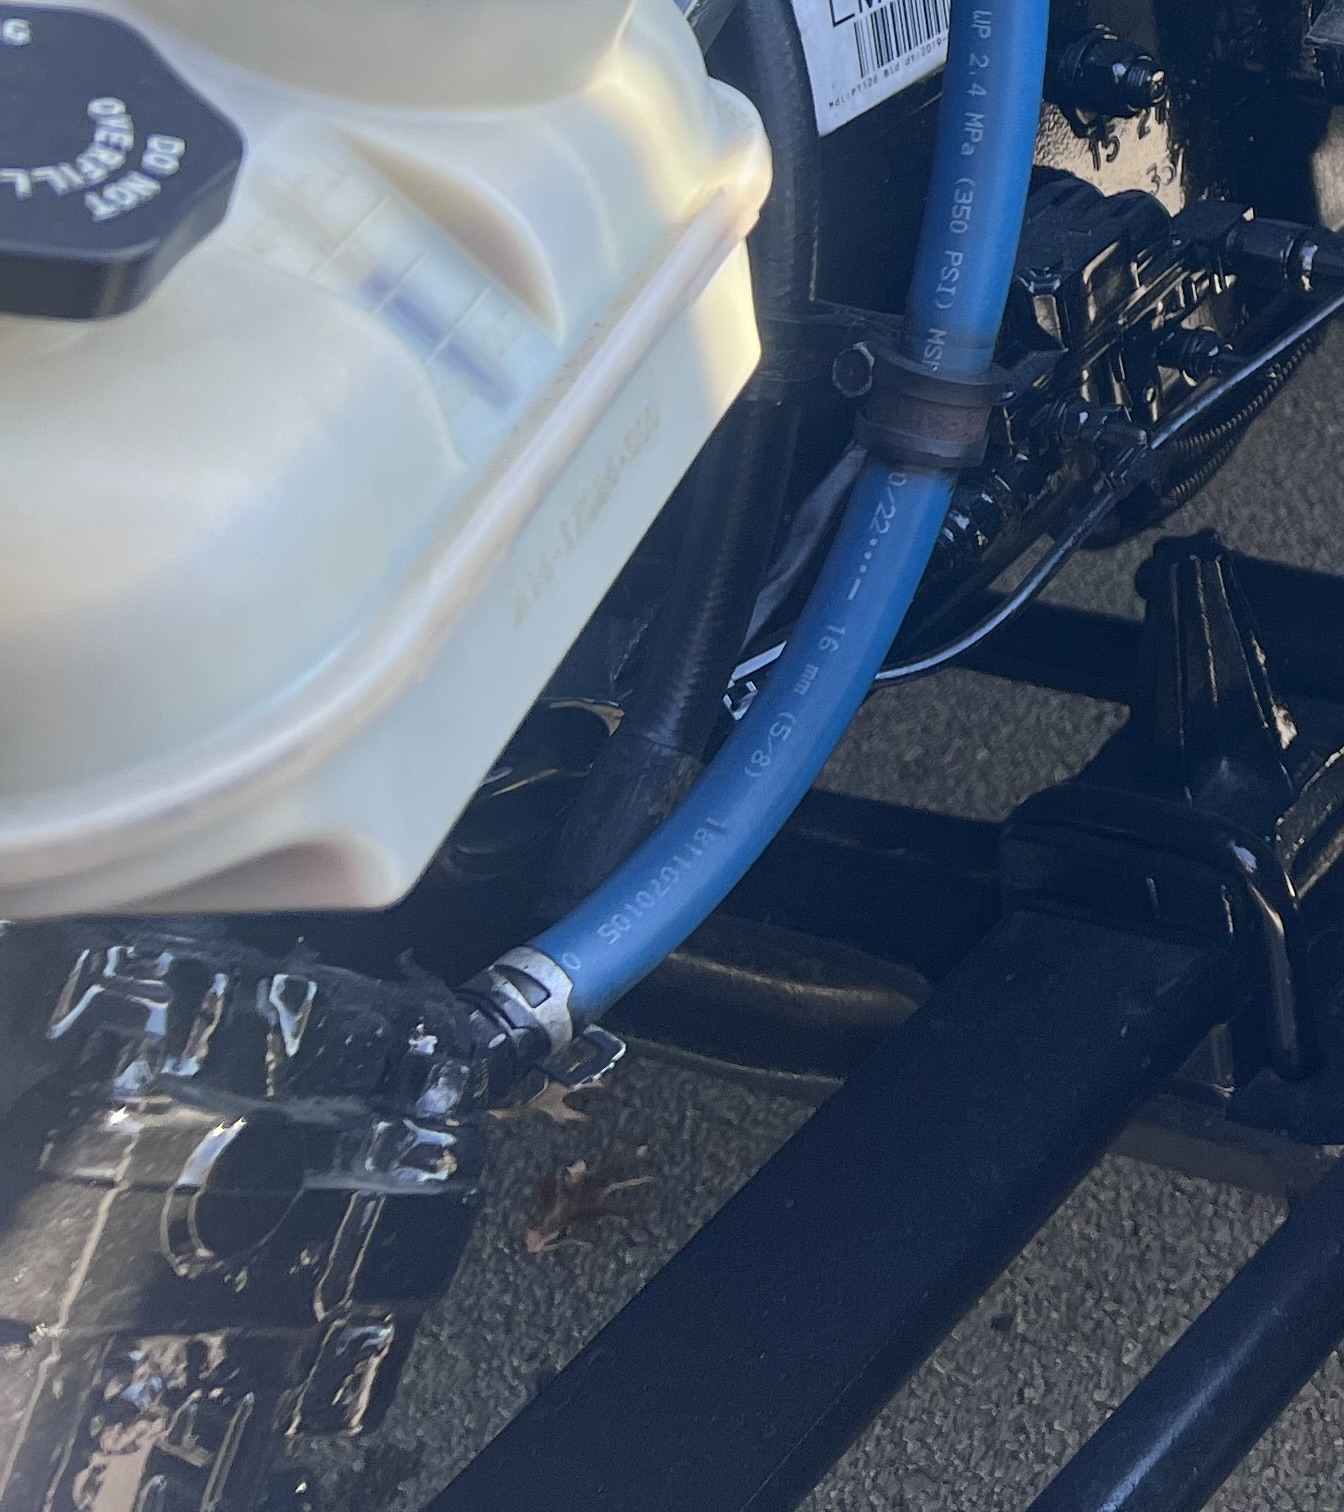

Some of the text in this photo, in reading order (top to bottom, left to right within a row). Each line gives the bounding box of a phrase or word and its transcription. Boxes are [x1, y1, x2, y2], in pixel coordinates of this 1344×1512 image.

[972, 9, 993, 39] WP
[960, 111, 985, 157] MPa
[83, 132, 187, 222] DO NOT
[949, 176, 976, 234] (350
[934, 249, 964, 311] PSI)
[818, 624, 847, 653] 16
[792, 663, 820, 696] mm
[744, 711, 798, 779] (5/8)
